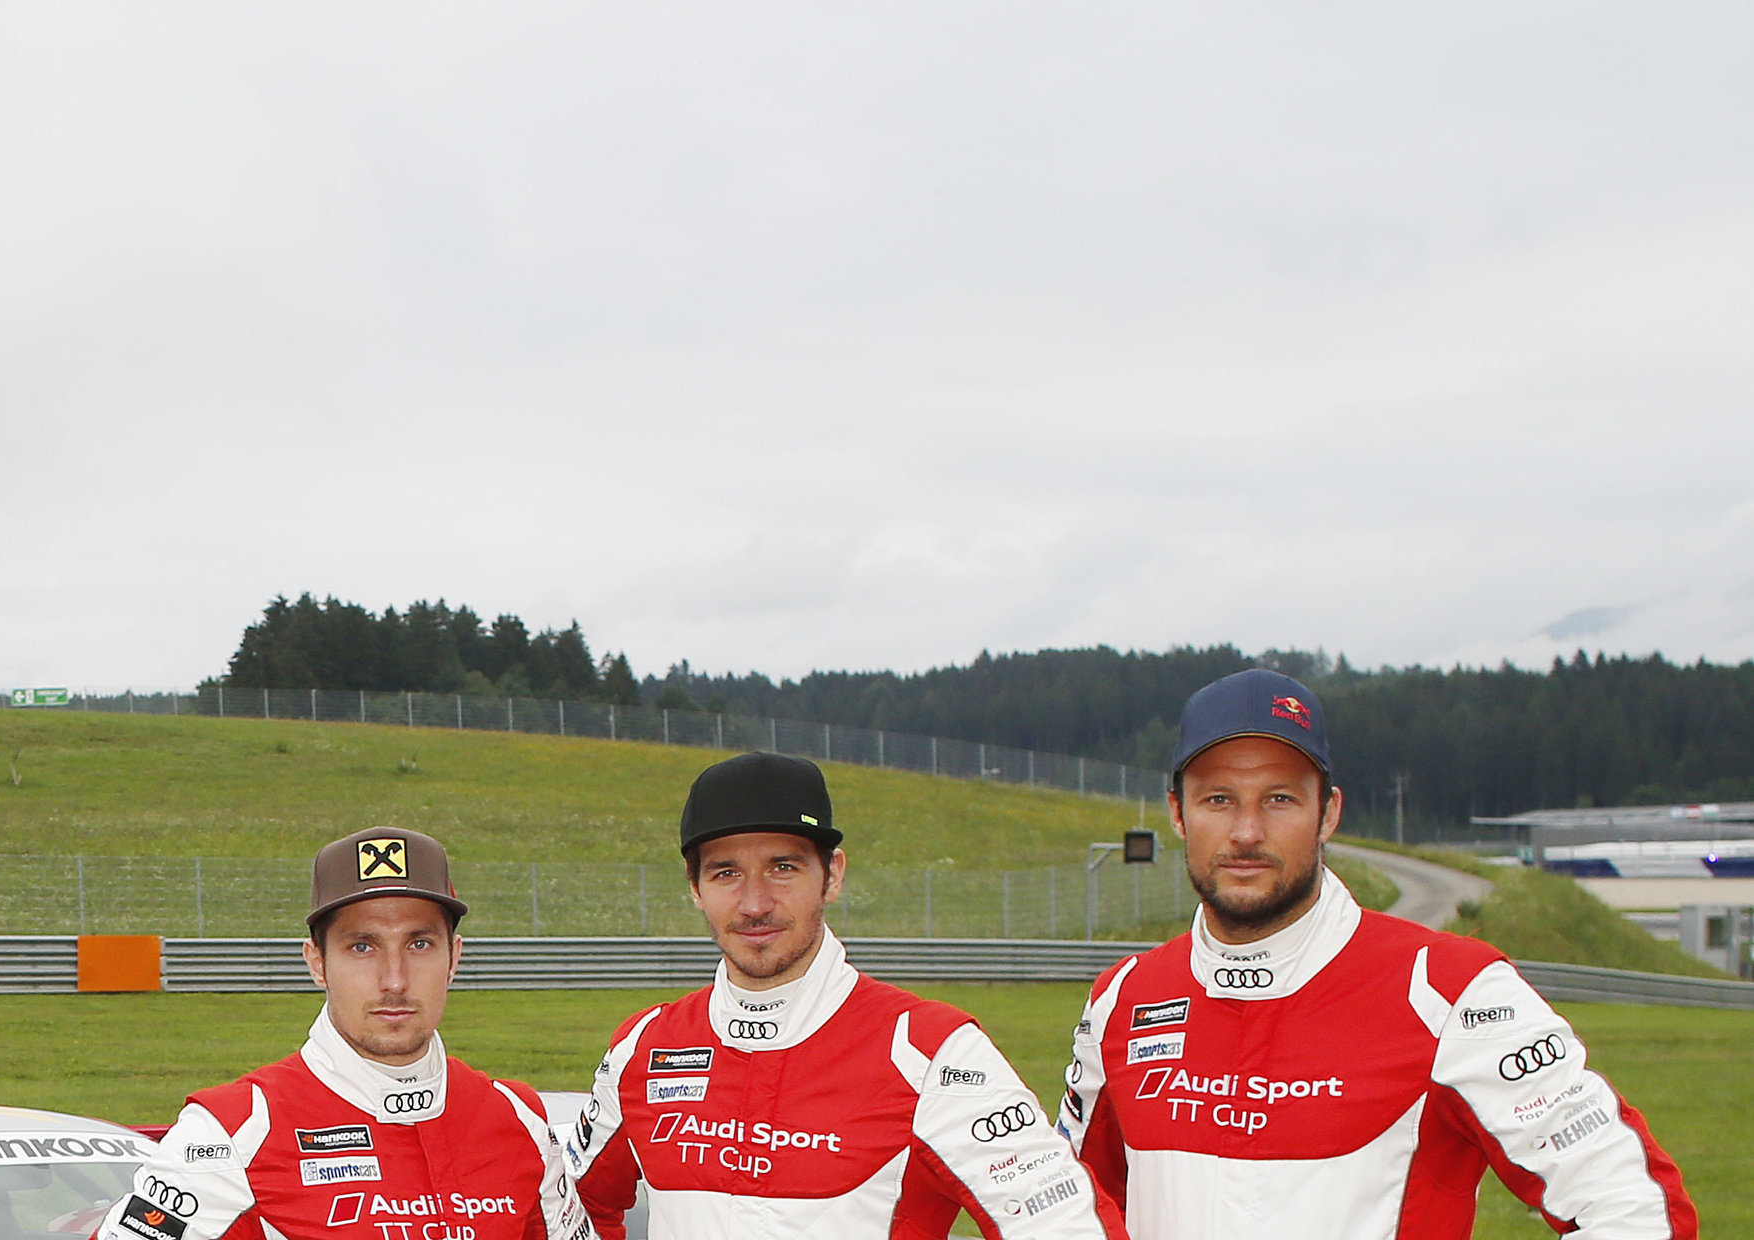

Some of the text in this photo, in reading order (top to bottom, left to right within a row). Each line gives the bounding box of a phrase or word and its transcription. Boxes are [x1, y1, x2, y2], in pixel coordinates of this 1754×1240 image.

[1272, 707, 1295, 721] Red
[1461, 1007, 1514, 1028] freem
[940, 1067, 986, 1086] freem
[1169, 1069, 1344, 1104] Audi Sport
[658, 1084, 704, 1100] sportscars
[1513, 1095, 1547, 1115] Audi
[1167, 1098, 1267, 1136] TT Cup
[1515, 1111, 1544, 1123] Top
[679, 1115, 842, 1153] Audi Sport
[1550, 1108, 1610, 1152] REHAU
[185, 1144, 230, 1162] freem
[677, 1142, 773, 1178] TT Cup
[319, 1163, 378, 1181] sportscars
[989, 1155, 1019, 1174] Audi
[991, 1151, 1062, 1185] Top Service
[450, 1192, 517, 1219] Sport
[1024, 1178, 1079, 1216] REHAU
